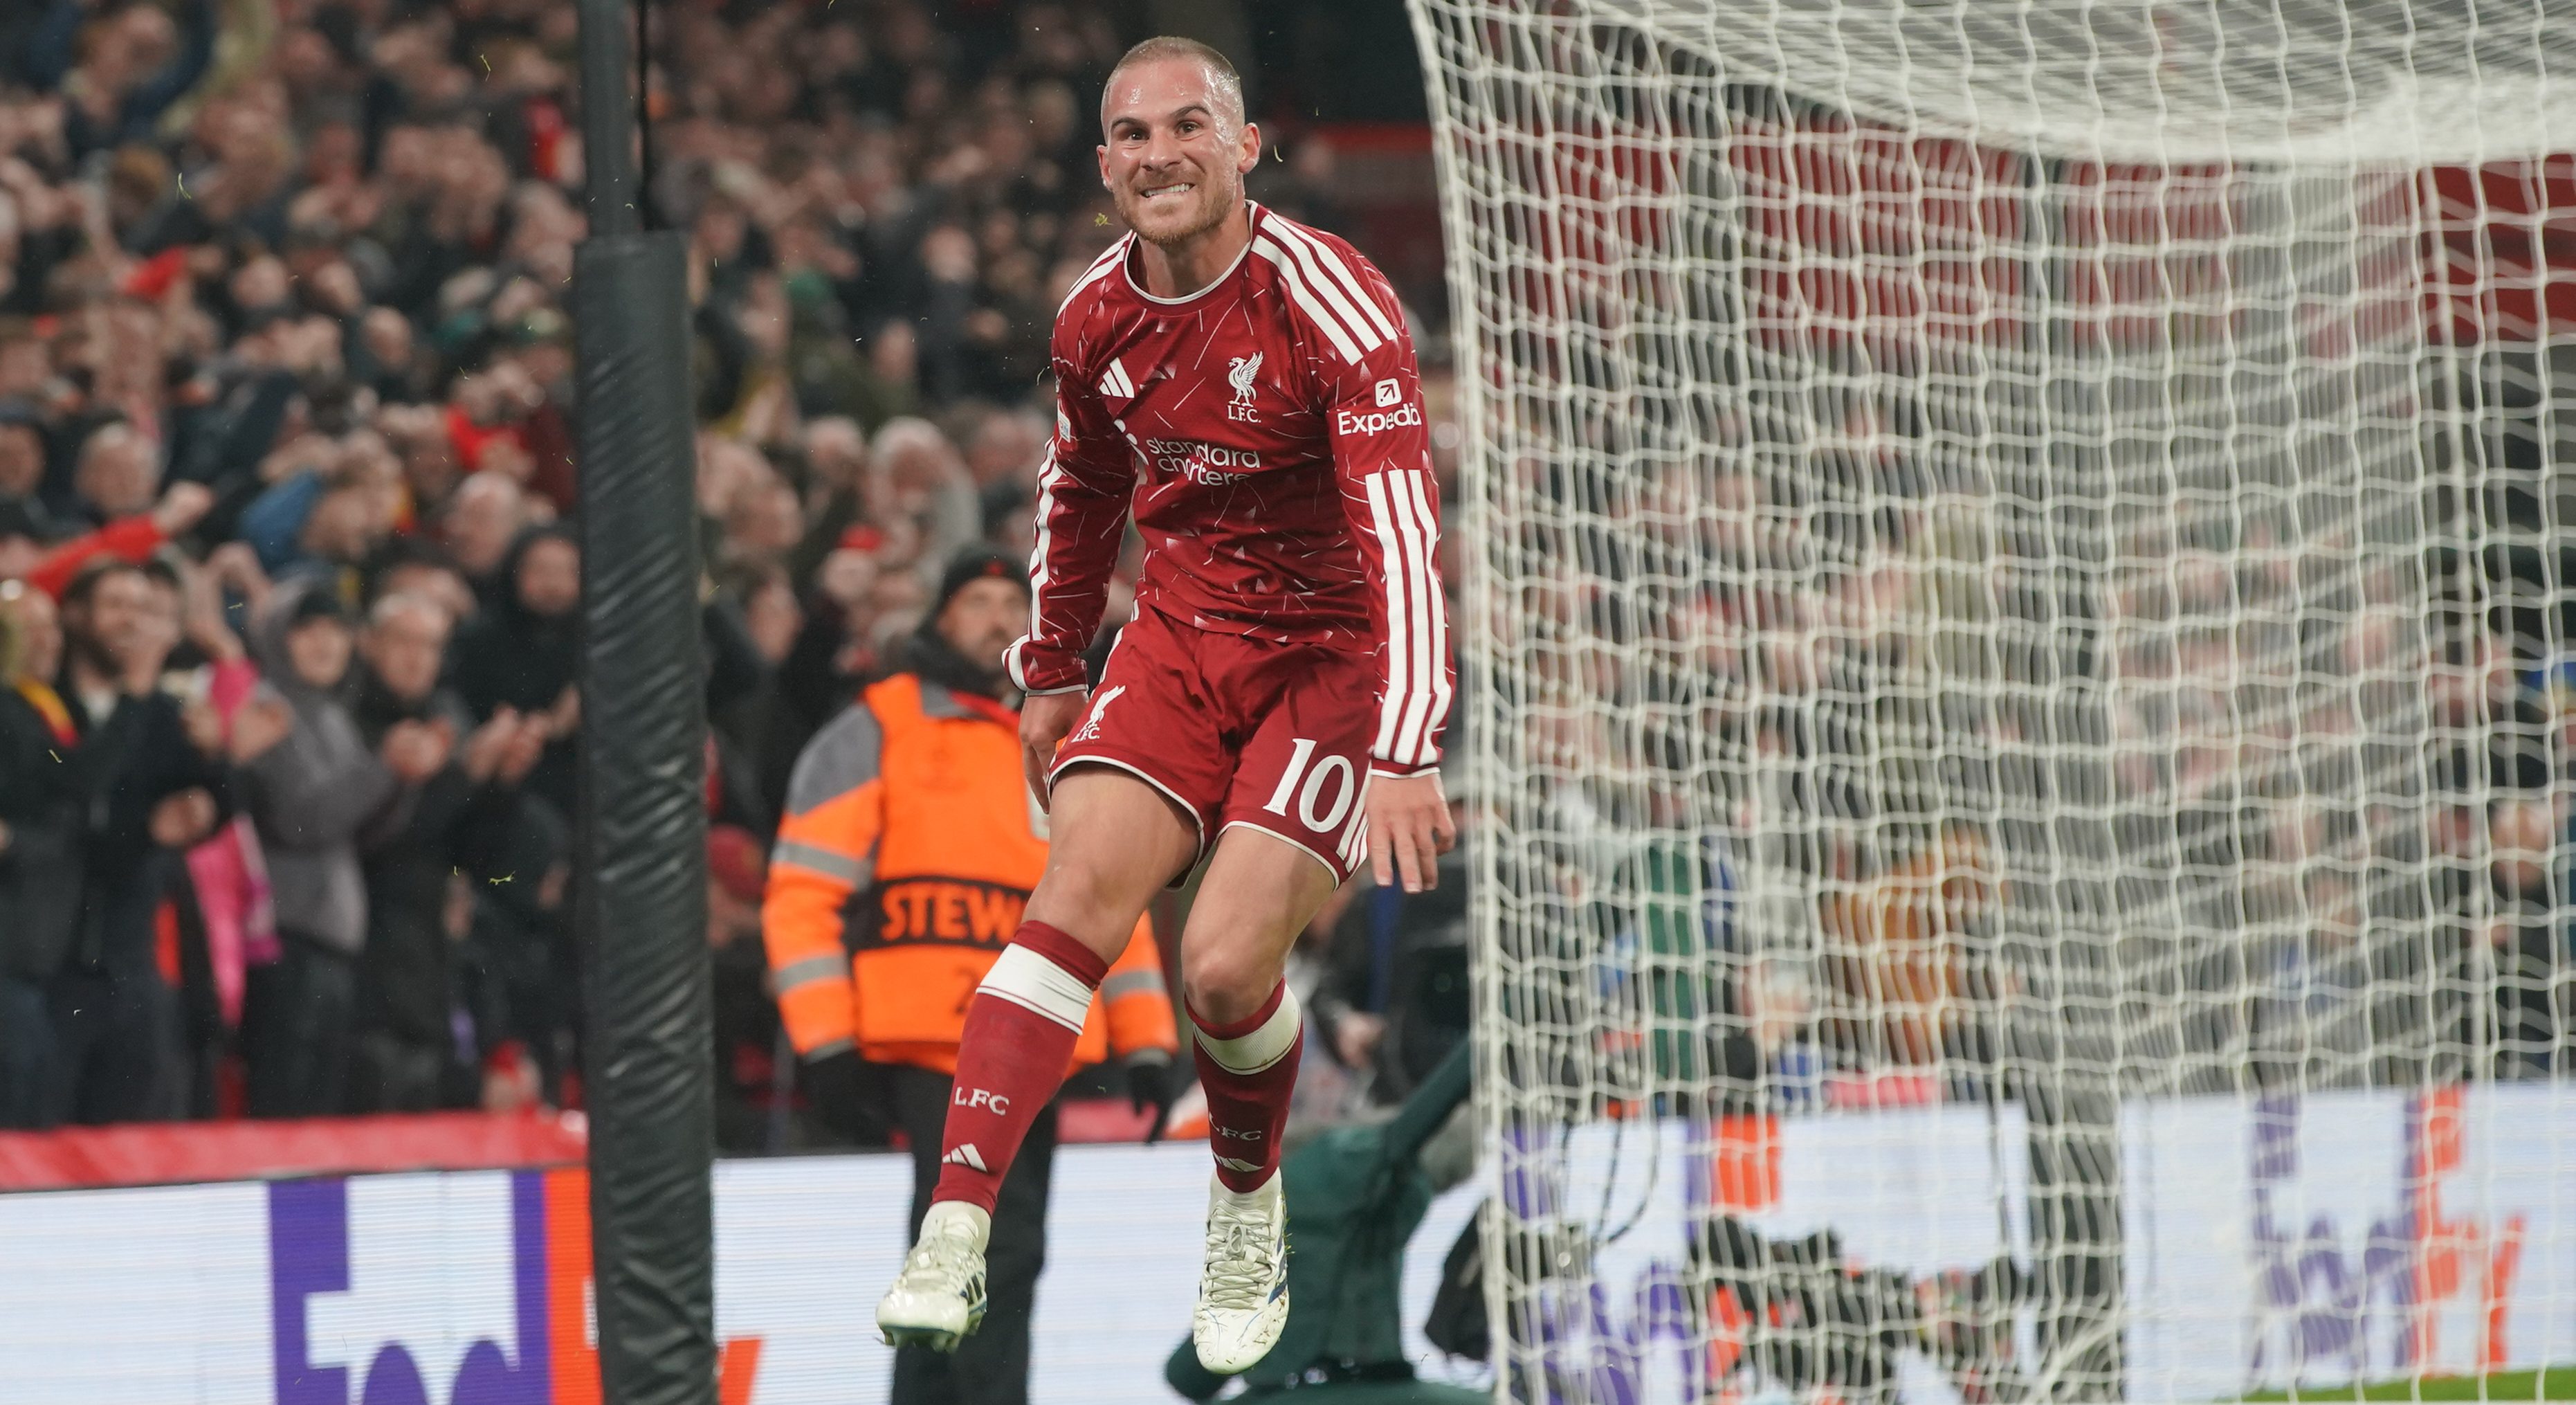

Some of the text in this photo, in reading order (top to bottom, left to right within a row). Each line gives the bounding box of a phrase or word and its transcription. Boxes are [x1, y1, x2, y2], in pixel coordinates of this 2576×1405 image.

[1146, 437, 1261, 469] standard
[1262, 738, 1355, 833] 10
[881, 881, 1023, 944] STEW
[955, 1086, 1010, 1116] LFC
